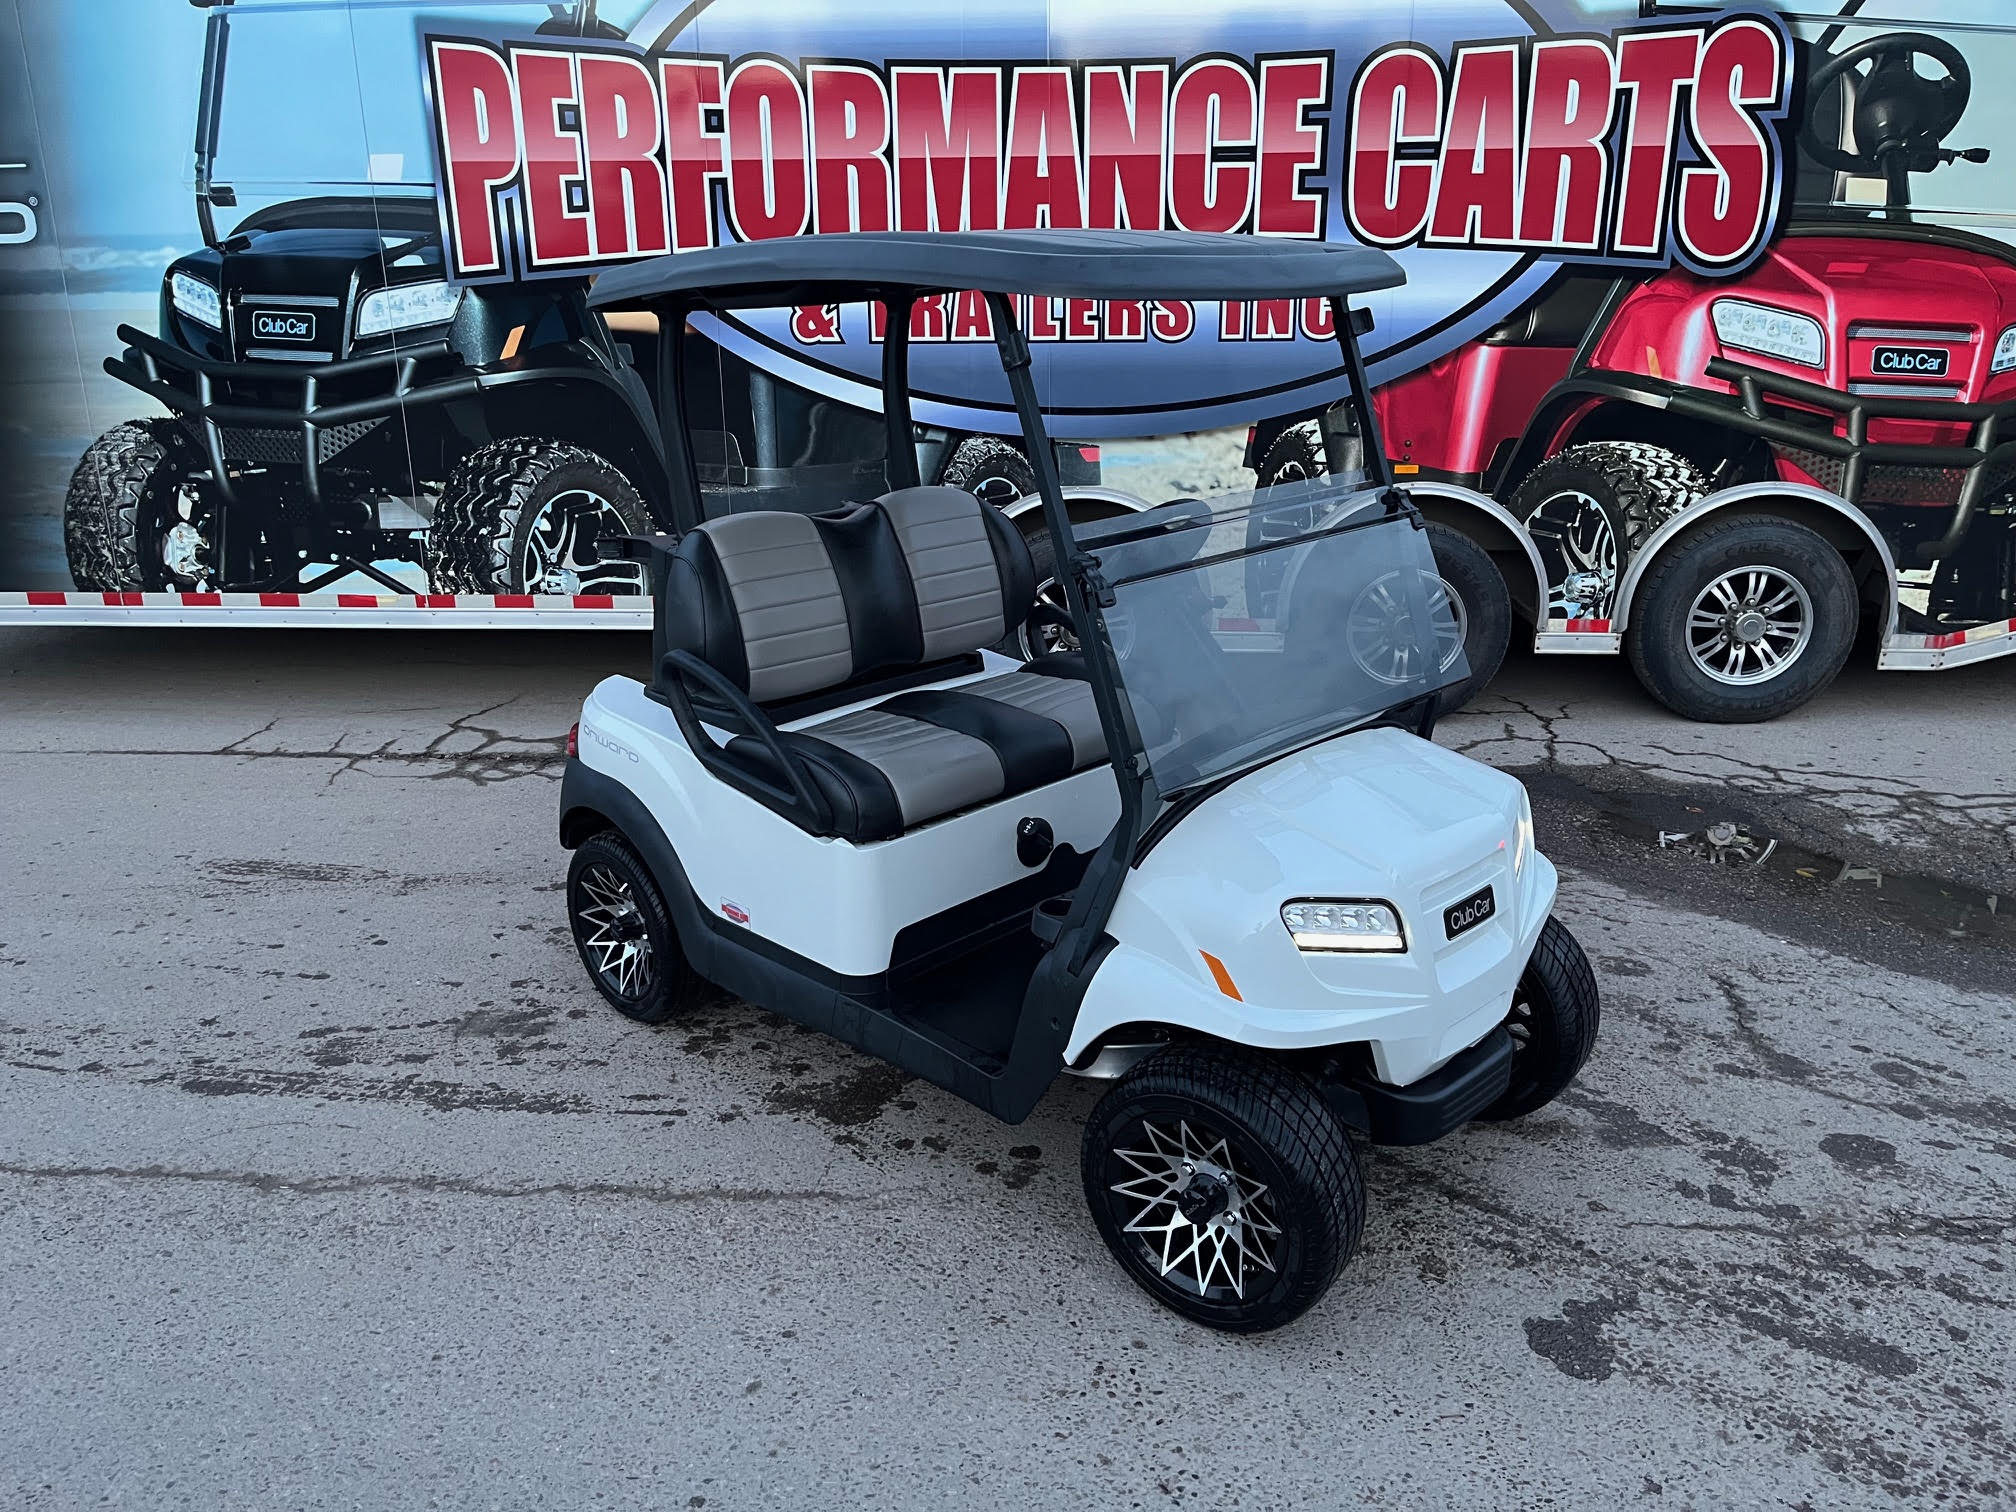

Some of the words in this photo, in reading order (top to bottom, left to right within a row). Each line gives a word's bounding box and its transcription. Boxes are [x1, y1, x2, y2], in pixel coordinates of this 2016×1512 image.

[432, 41, 1329, 272] PERFORMANCE
[1348, 20, 1780, 263] CARTS
[259, 317, 286, 334] Club
[286, 318, 309, 335] Car
[791, 303, 842, 343] &
[868, 289, 1193, 341] RALERS
[1880, 352, 1915, 369] Club
[1915, 353, 1942, 370] Car
[1451, 906, 1475, 930] Club
[1474, 897, 1491, 917] Car
